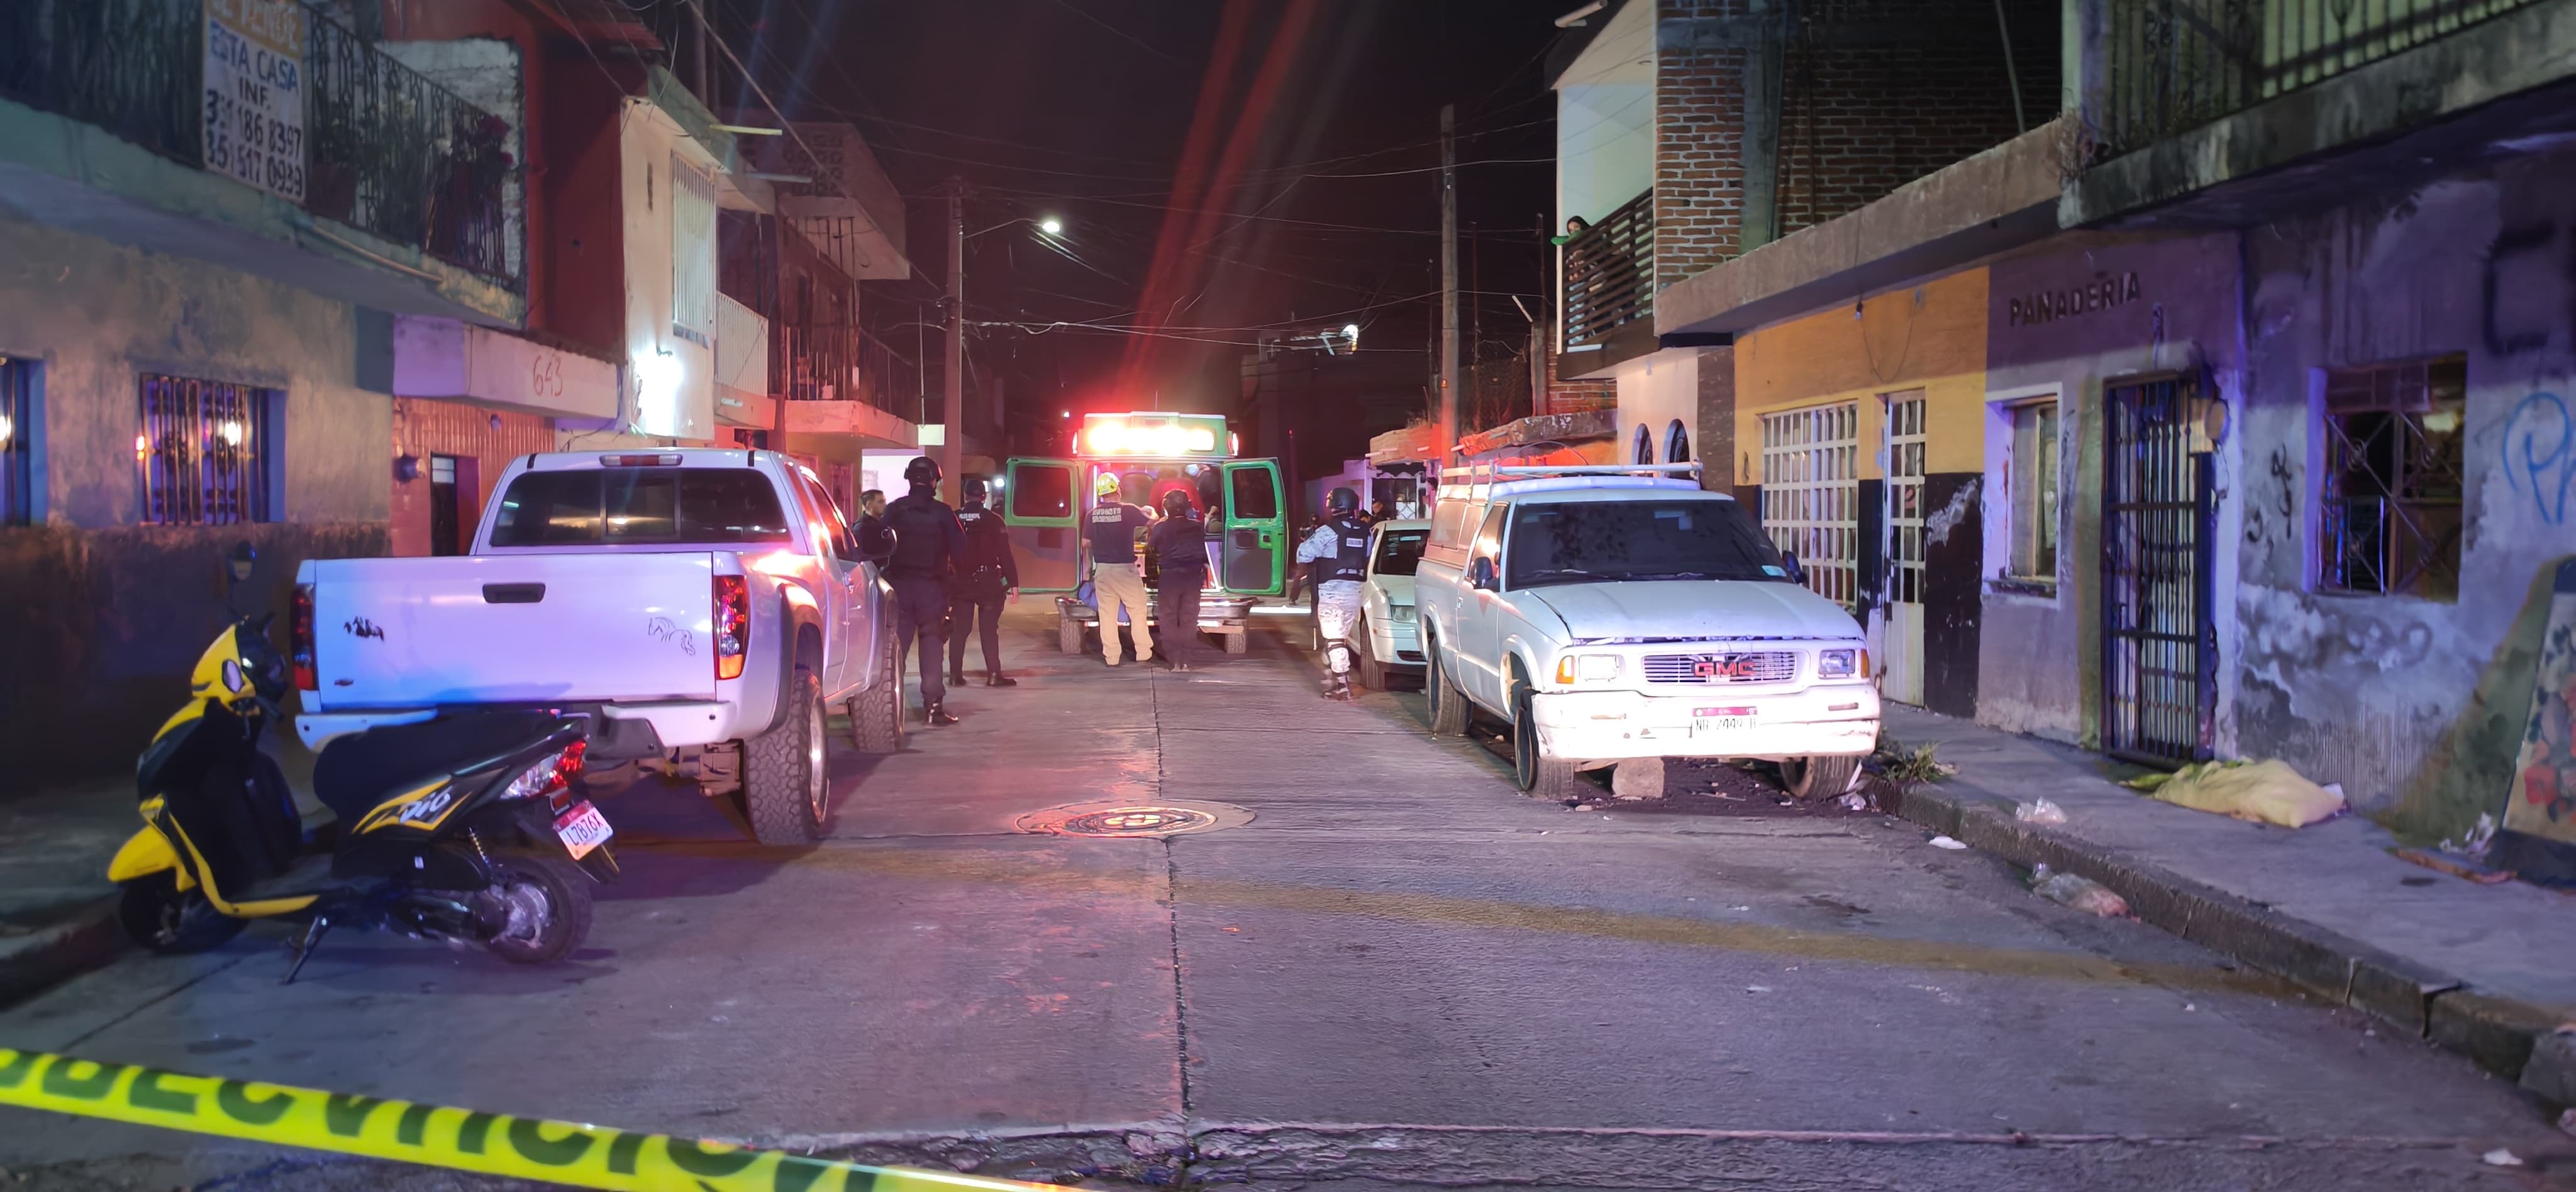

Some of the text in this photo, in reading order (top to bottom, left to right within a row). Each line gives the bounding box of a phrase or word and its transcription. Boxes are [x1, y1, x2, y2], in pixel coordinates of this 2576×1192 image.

[210, 19, 299, 94] ESTA CASA
[238, 76, 272, 111] INF.
[238, 143, 262, 183] 517
[533, 355, 564, 397] 643
[1694, 661, 1757, 678] GMC
